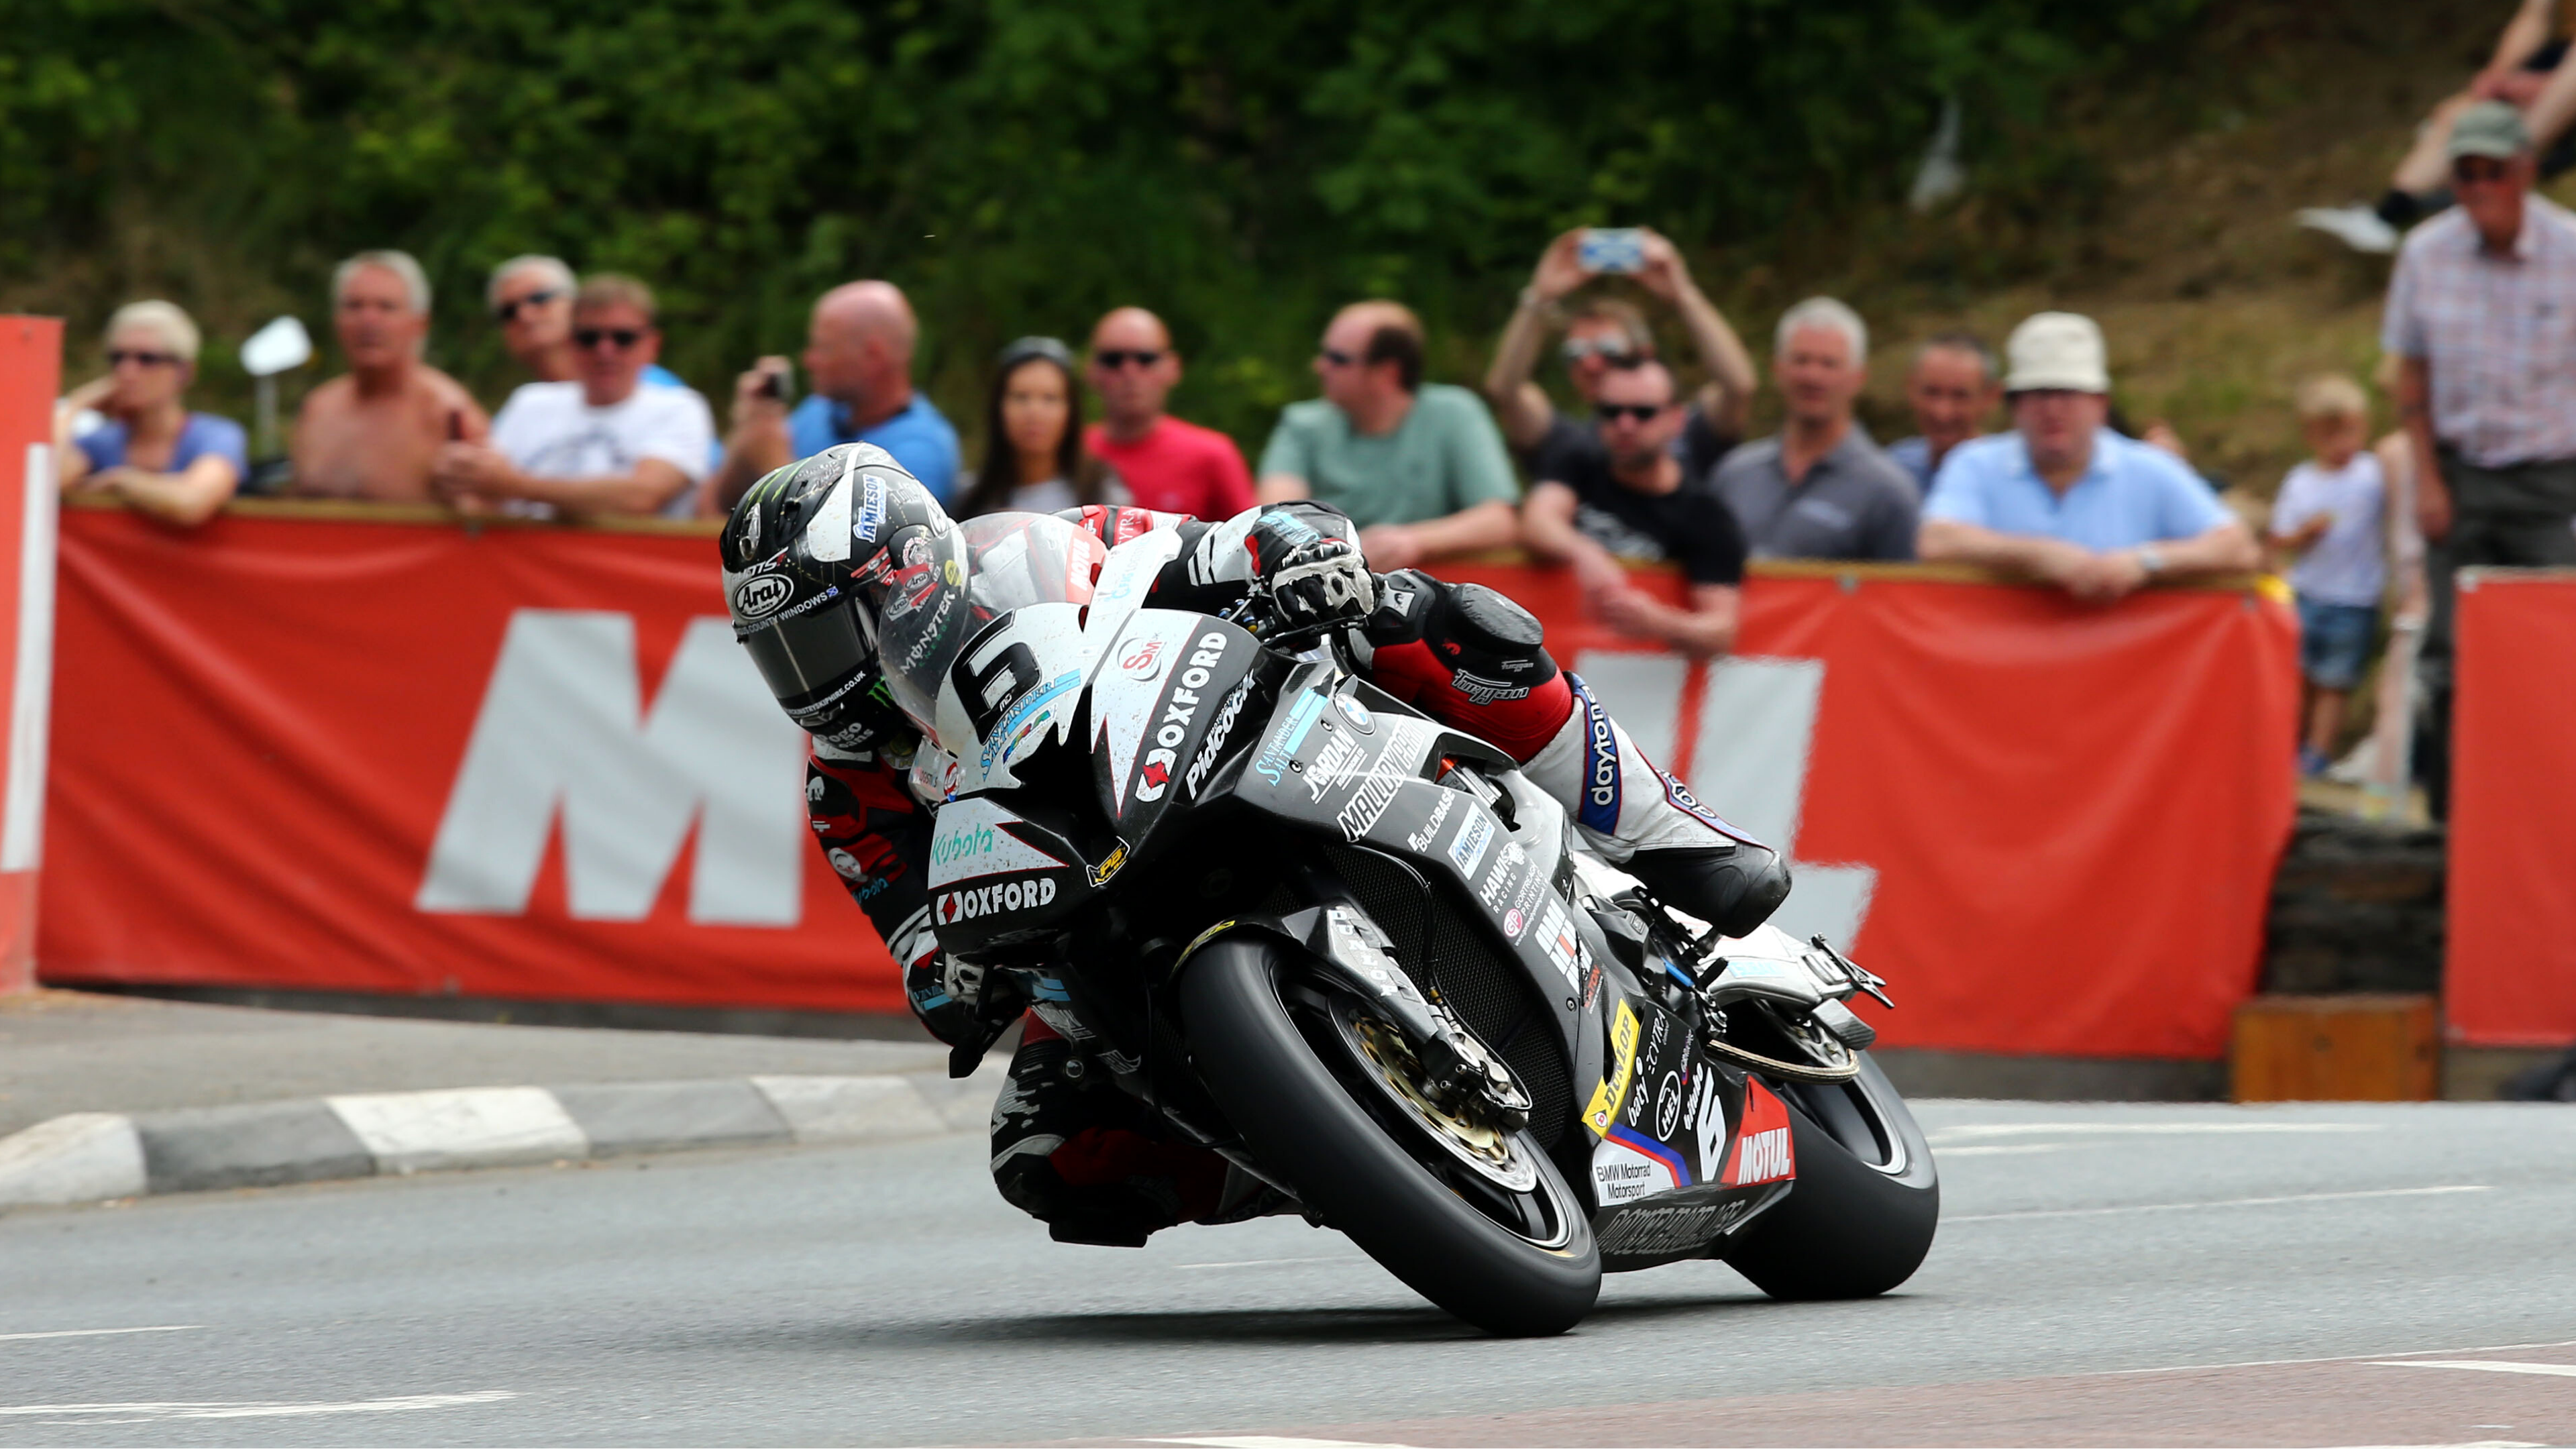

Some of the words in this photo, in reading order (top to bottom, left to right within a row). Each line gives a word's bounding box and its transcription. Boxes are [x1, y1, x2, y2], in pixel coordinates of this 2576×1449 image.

[861, 475, 879, 542] JAMIESON
[907, 572, 927, 588] Arai
[1070, 538, 1091, 592] MOTUL
[739, 577, 782, 613] Arai
[778, 591, 828, 621] WINDOWS
[1157, 631, 1228, 746] OXFORD
[1255, 716, 1299, 787] SANTANDER
[1581, 685, 1617, 806] daytona
[1336, 735, 1407, 843] MALLORY
[931, 822, 994, 866] Kubota
[1415, 786, 1456, 853] BUILDBASE
[1456, 812, 1487, 870] JAMIESON
[963, 877, 1057, 919] OXFORD
[1493, 872, 1517, 914] RACING
[1520, 869, 1544, 917] PRINTING
[1328, 910, 1398, 996] DUNLOP
[1604, 1014, 1631, 1111] DUNLOP
[1627, 1075, 1649, 1127] baty
[1661, 1089, 1679, 1134] HEL
[1697, 1067, 1726, 1182] 6
[1596, 1165, 1621, 1183] BMW
[1620, 1161, 1652, 1180] Motorrad
[1736, 1127, 1791, 1186] MOTUL
[1607, 1183, 1646, 1199] Motorsport
